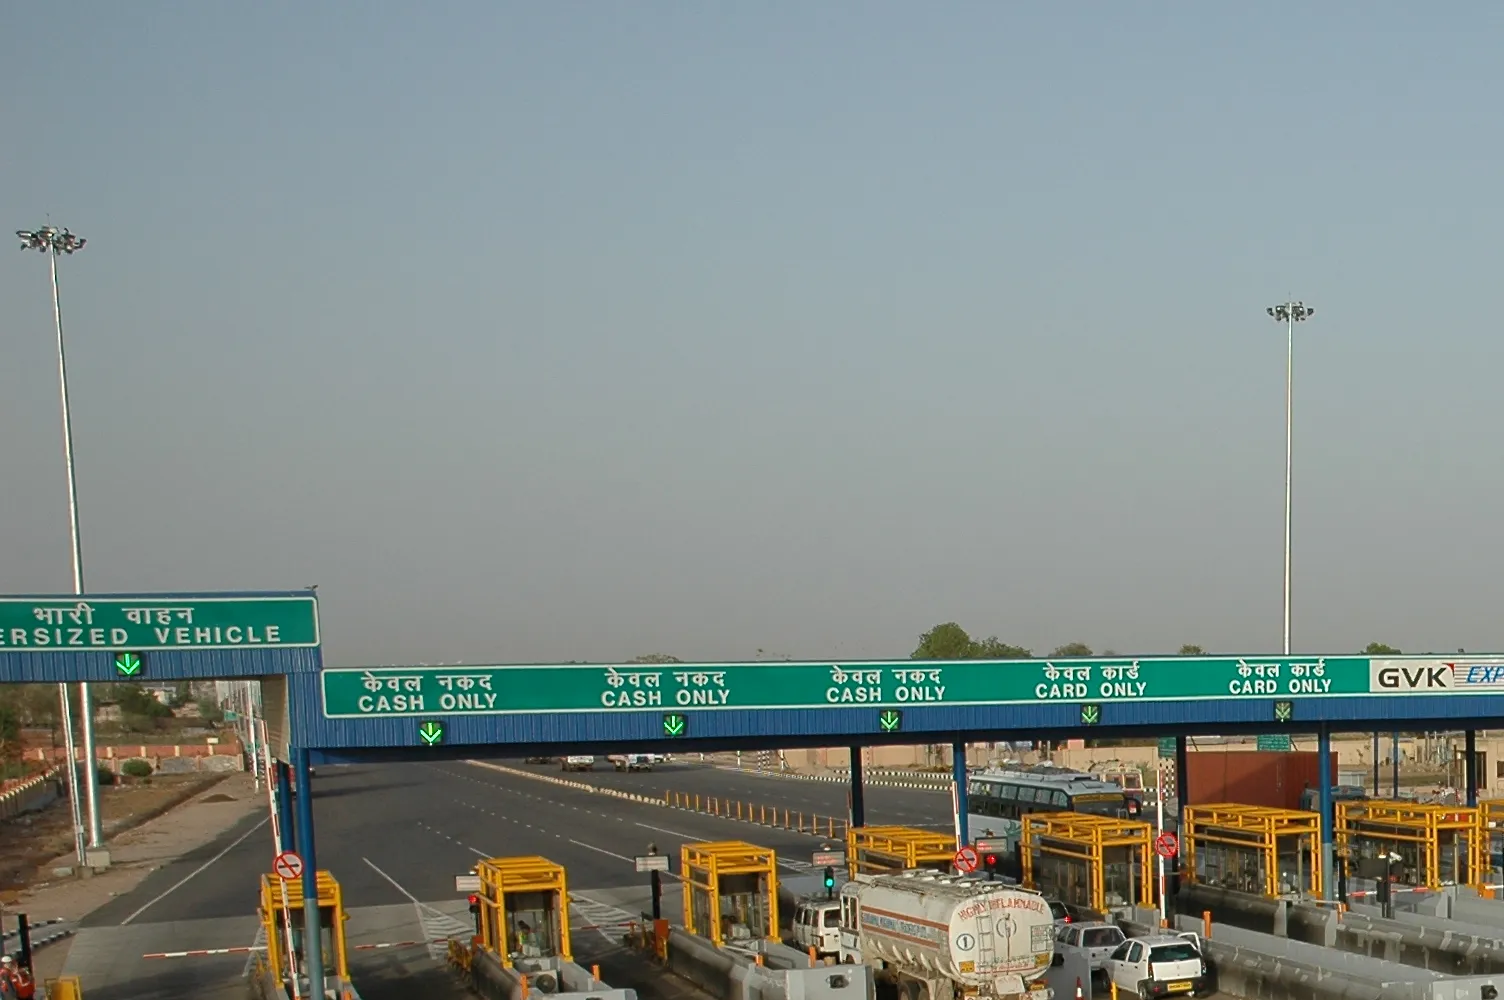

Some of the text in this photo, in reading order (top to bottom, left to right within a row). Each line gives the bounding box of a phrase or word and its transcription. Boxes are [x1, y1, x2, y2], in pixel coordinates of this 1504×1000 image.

[33, 602, 194, 625] भारी वाहन
[156, 625, 282, 644] VEHICLE
[604, 667, 727, 688] केवल नकद
[830, 665, 942, 685] केवल नकद
[1043, 660, 1140, 682] केवल कार्ड
[1236, 658, 1326, 678] केवल कार्ड
[1378, 666, 1448, 689] GVK
[360, 670, 494, 693] केवल नकद
[1035, 681, 1147, 699] CARD ONLY
[1229, 678, 1332, 695] CARD ONLY
[358, 693, 498, 713] CASH ONLY
[601, 688, 730, 708] CASH ONLY
[826, 685, 946, 703] CASH ONLY
[957, 901, 986, 921] HIGHLY
